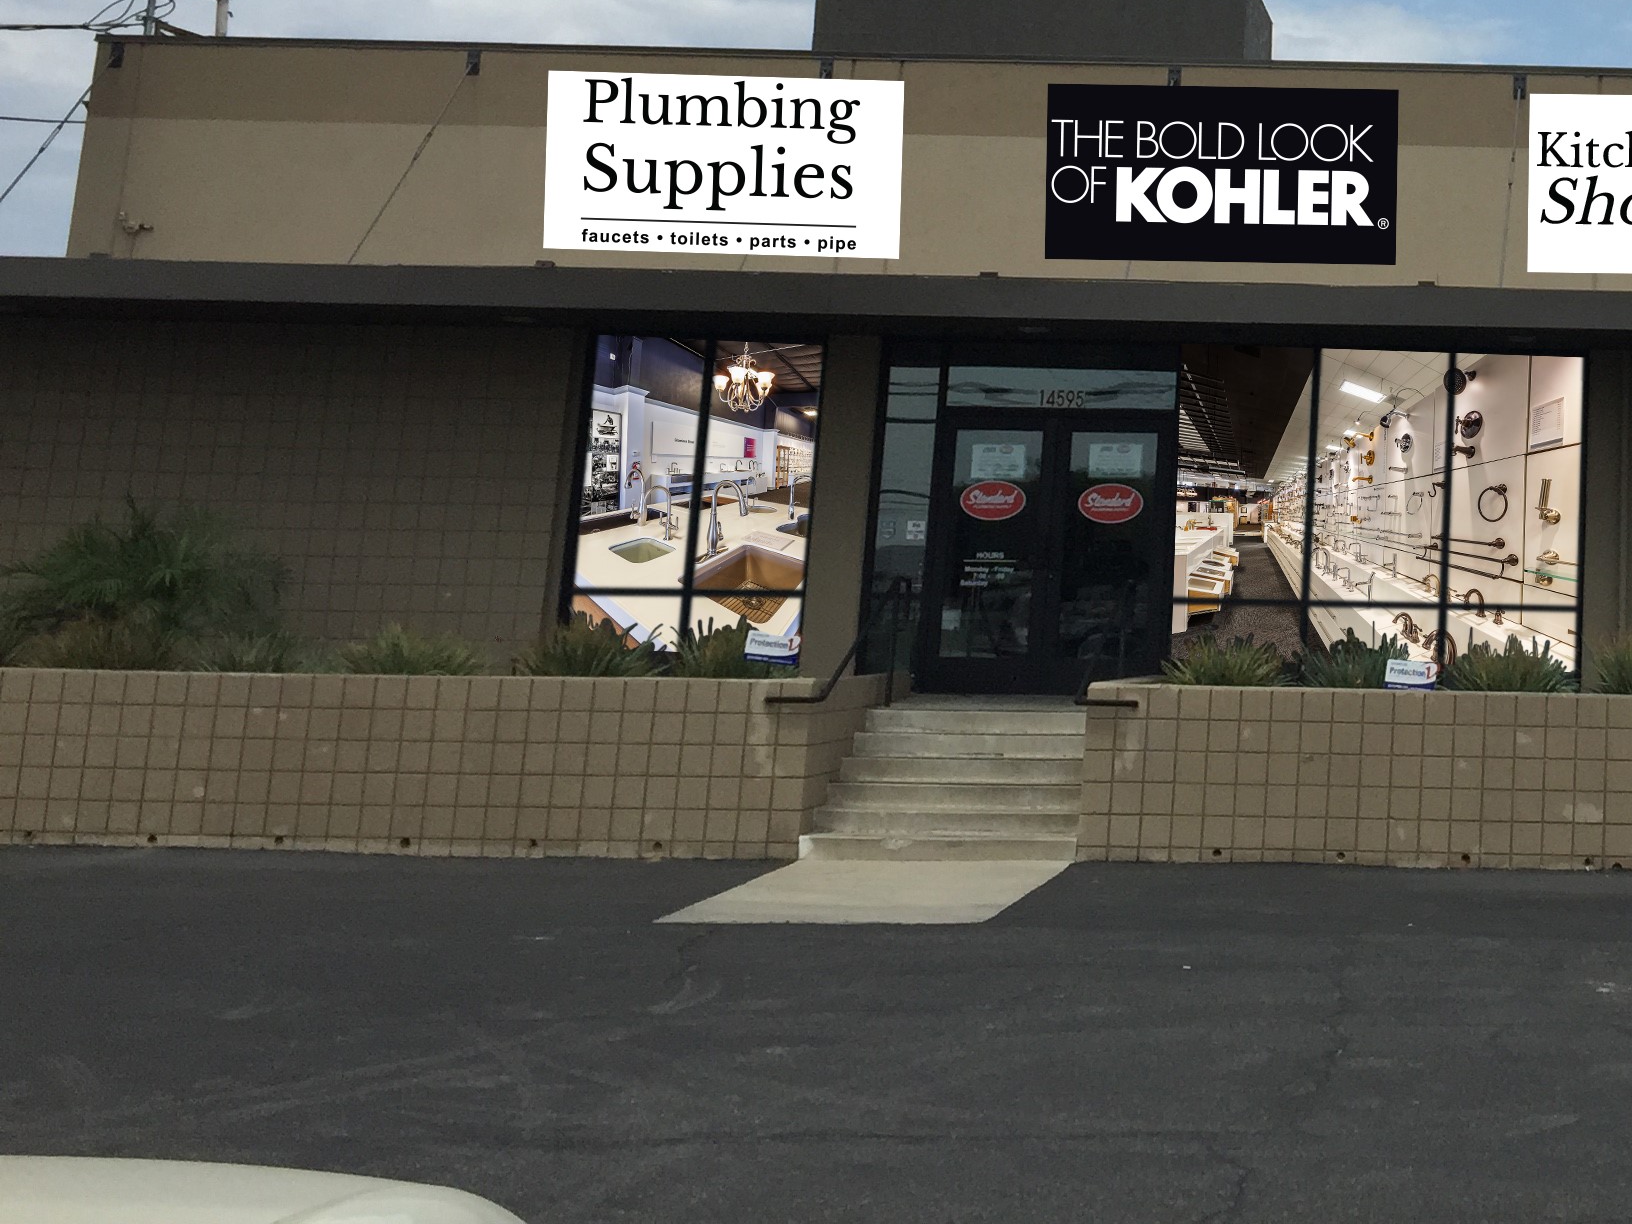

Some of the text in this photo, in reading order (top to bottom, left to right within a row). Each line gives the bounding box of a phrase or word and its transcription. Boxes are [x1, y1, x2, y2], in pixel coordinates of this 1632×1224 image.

[583, 78, 860, 144] Plumbing
[1052, 120, 1373, 162] THE BOLD LOOK
[584, 143, 852, 211] Supplies
[1052, 166, 1106, 203] OF
[1116, 167, 1374, 226] KOHLER
[582, 229, 856, 252] faucets toilets parts pipe
[1040, 389, 1084, 408] 14595
